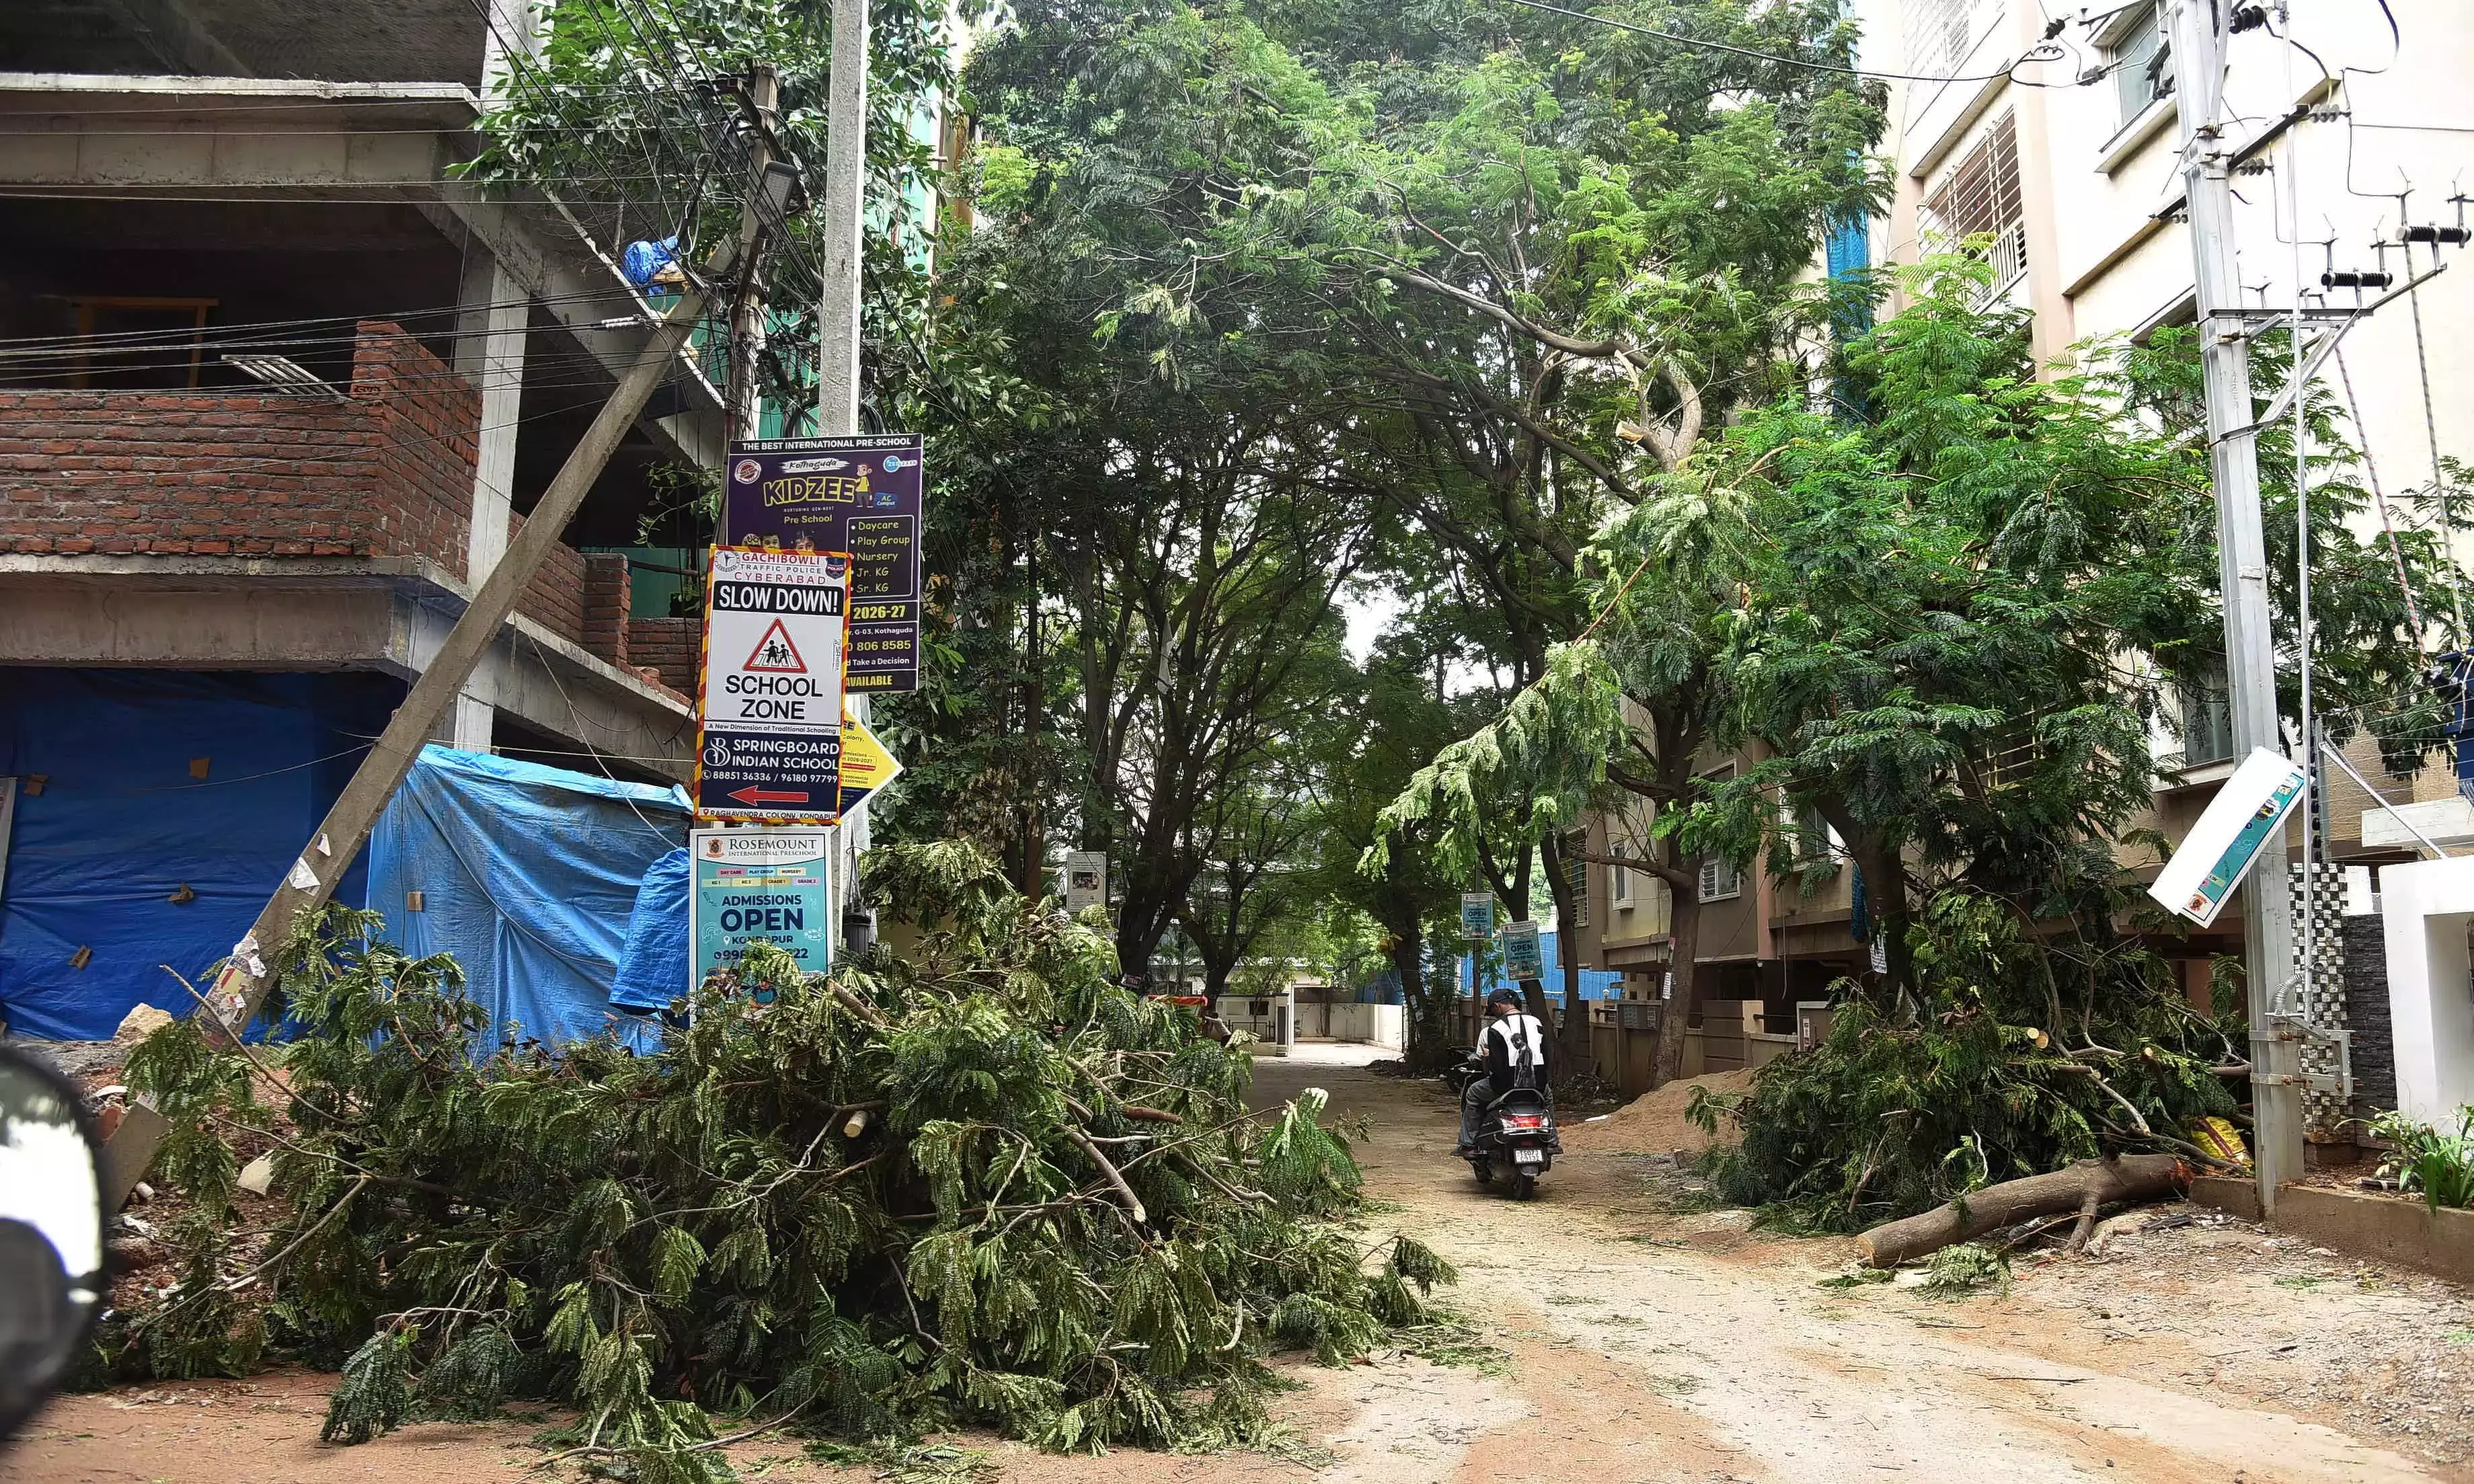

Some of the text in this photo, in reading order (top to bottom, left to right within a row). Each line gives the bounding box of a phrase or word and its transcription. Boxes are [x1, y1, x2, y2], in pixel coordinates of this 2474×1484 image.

[742, 438, 911, 451] THE BEST INTERNATIONAL PRE-SCHOOL
[763, 476, 855, 506] KIDZEE
[784, 514, 833, 524] Pre School
[858, 522, 899, 532] Daycare
[857, 536, 910, 547] Play Group
[742, 553, 820, 565] GACHIBOWLI
[857, 553, 898, 562] Nursery
[740, 564, 822, 574] TRAFFIC POLICE
[857, 567, 889, 577] Jr. KG
[734, 572, 826, 584] CYBERABAD
[856, 583, 889, 592] Sr. KG
[719, 586, 838, 613] SLOW DOWN!
[853, 605, 906, 619] 2026-27
[874, 627, 913, 635] Kothaguda
[857, 641, 878, 652] 806
[882, 640, 911, 650] 8585
[877, 657, 910, 665] Decision
[725, 674, 823, 697] SCHOOL
[845, 675, 893, 687] AVAILABLE
[740, 699, 806, 719] ZONE
[806, 727, 837, 735] Schooling
[733, 739, 839, 755] SPRINGBOARD
[732, 755, 839, 770] INDIAN SCHOOL
[713, 771, 740, 780] 88851
[742, 772, 771, 781] 36336
[774, 773, 779, 782] /
[781, 773, 807, 783] 96180
[810, 775, 838, 783] 97799
[710, 810, 763, 818] RAGHAVENDRA
[730, 838, 817, 851] ROSEMOUNT
[722, 894, 802, 906] ADMISSIONS
[720, 908, 804, 932] OPEN
[1510, 943, 1533, 953] OPEN
